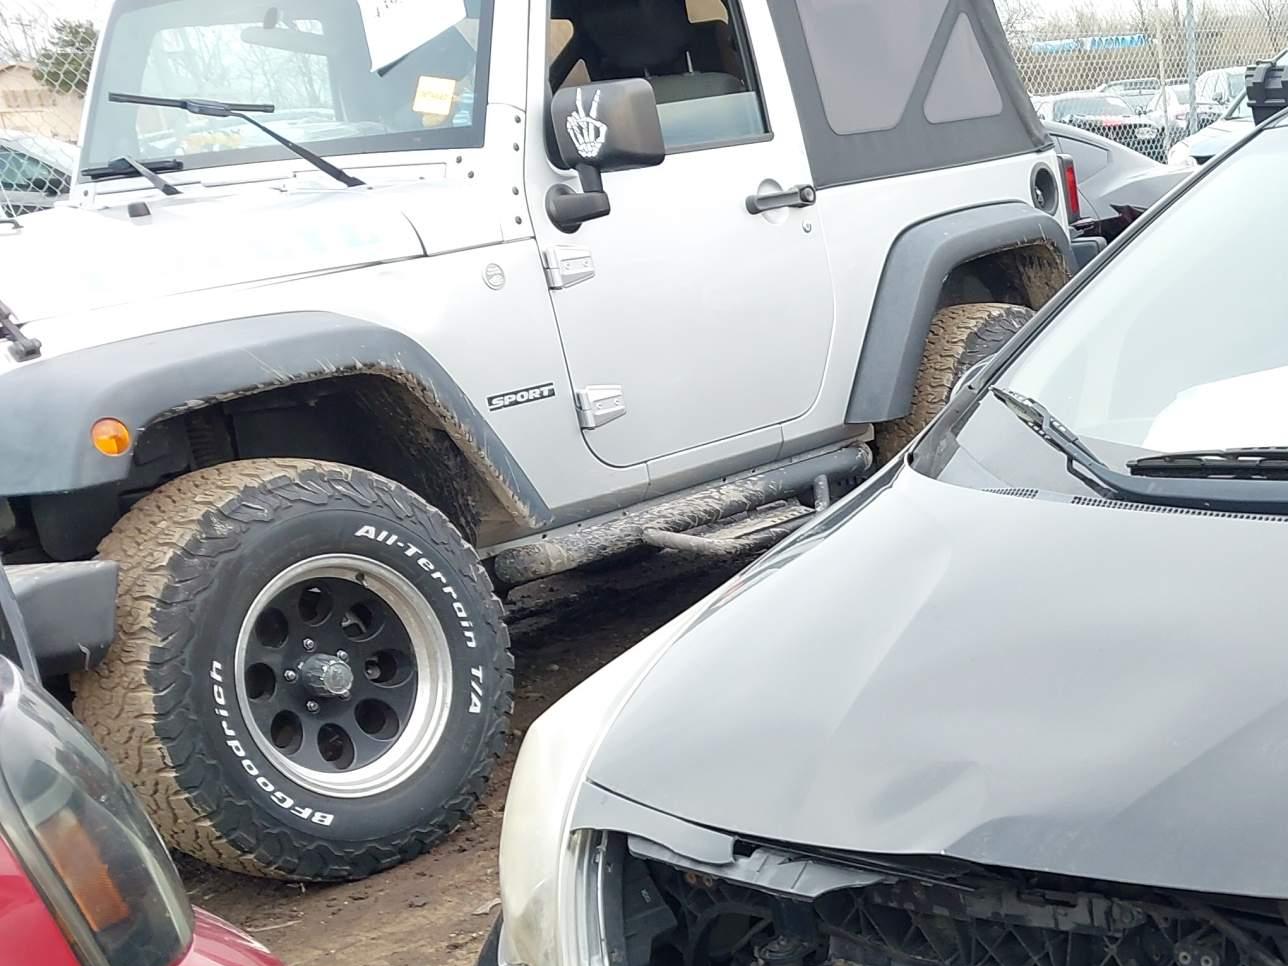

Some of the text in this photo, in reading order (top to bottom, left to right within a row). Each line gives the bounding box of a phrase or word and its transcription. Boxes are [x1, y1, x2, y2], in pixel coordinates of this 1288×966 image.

[490, 386, 551, 408] SPORT
[354, 524, 484, 714] All-Terrain T/A
[209, 660, 335, 827] BFGoodrich
